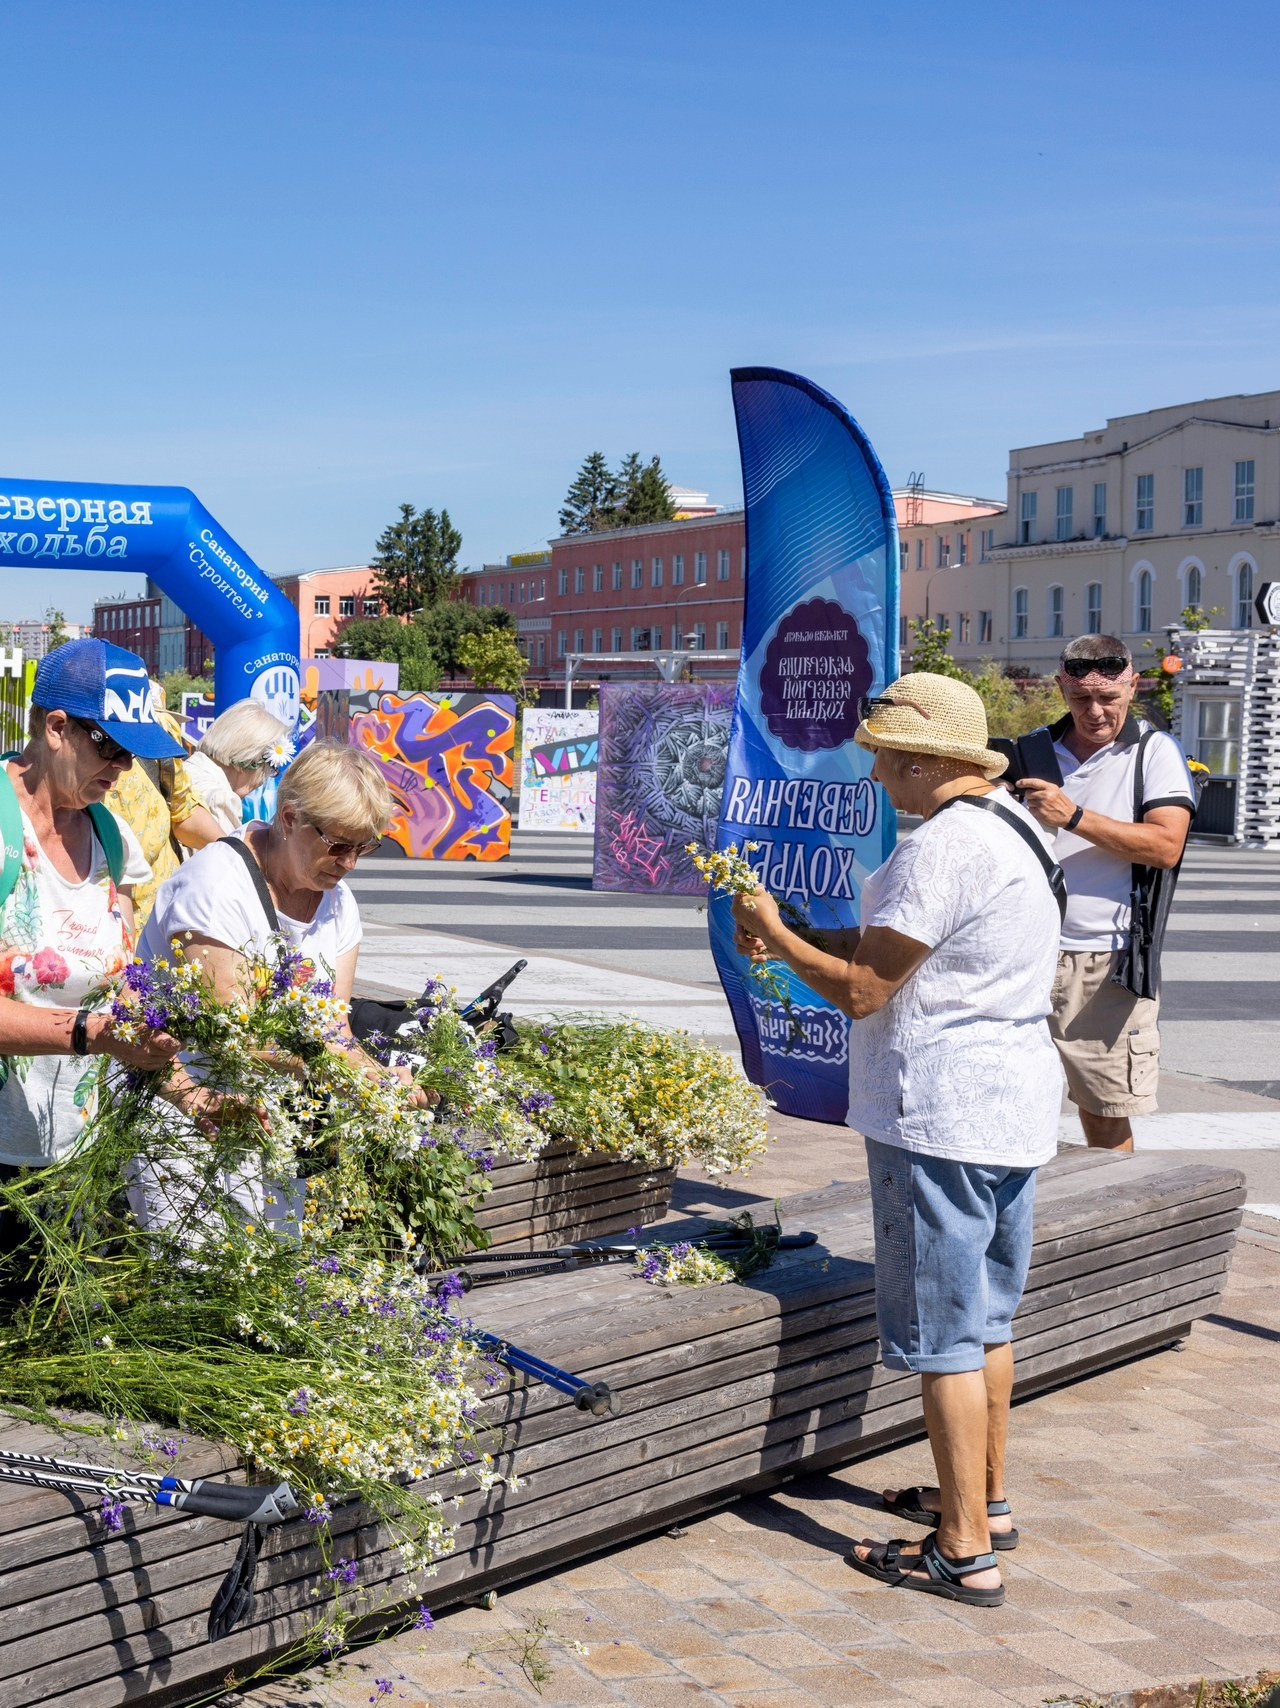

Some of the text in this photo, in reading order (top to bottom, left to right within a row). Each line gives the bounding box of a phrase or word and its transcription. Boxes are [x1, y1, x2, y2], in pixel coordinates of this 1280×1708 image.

[200, 528, 269, 604] Санаторий
[243, 652, 300, 675] Санатори
[56, 931, 105, 958] Summer
